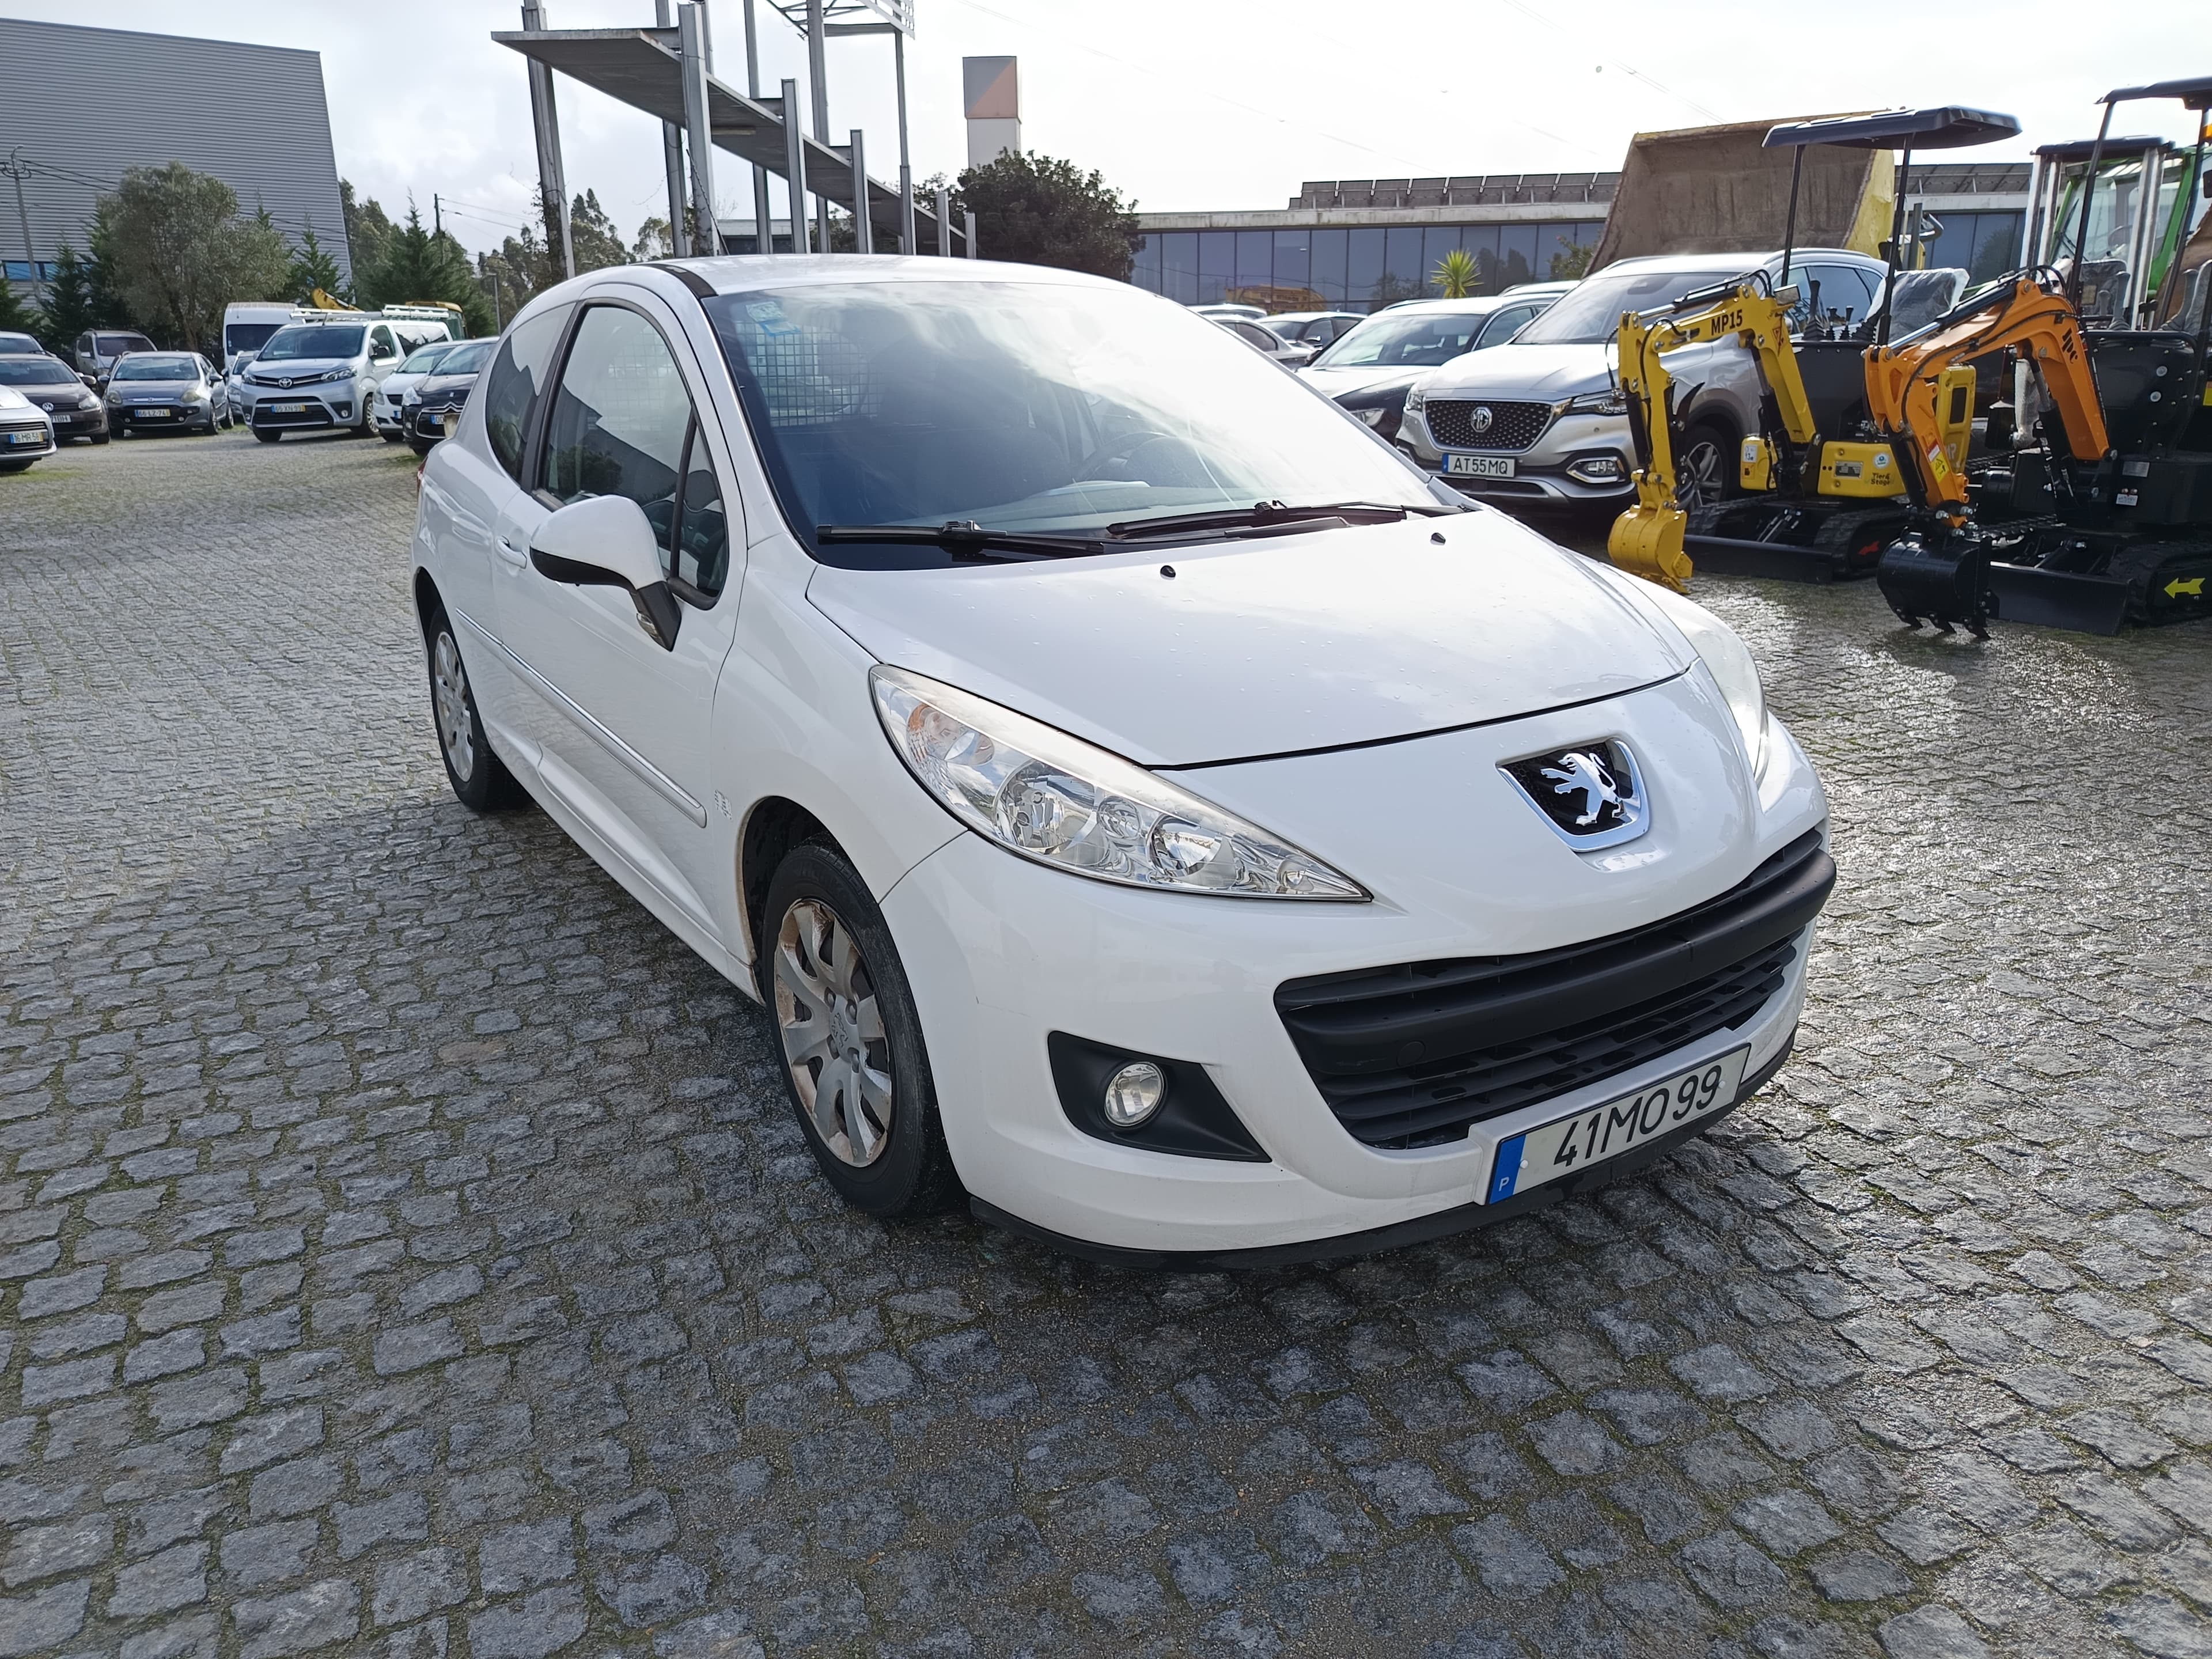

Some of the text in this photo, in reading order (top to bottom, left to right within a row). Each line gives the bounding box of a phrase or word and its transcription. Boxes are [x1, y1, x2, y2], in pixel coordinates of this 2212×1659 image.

[1711, 308, 1743, 336] MP15
[1453, 457, 1508, 475] AT55MQ
[1553, 1065, 1722, 1167] 41MO99
[1498, 1176, 1509, 1192] P
